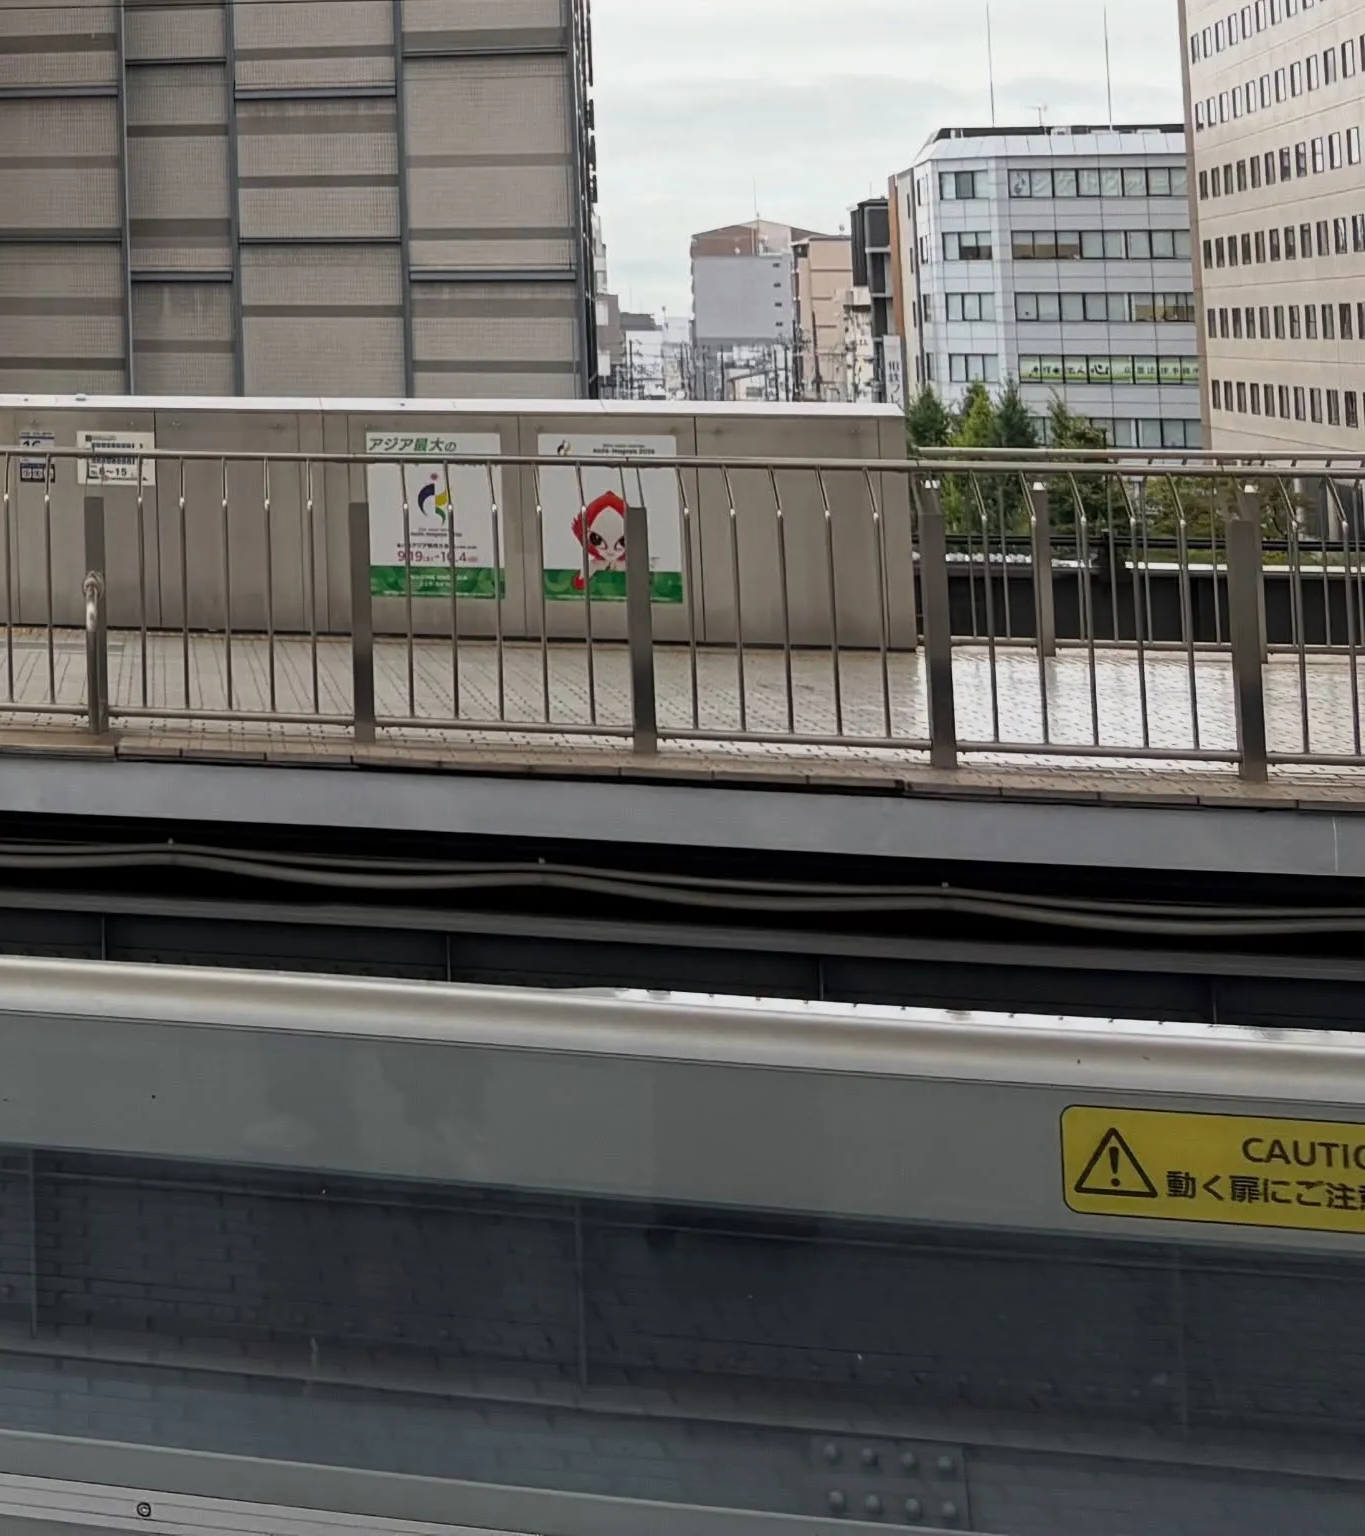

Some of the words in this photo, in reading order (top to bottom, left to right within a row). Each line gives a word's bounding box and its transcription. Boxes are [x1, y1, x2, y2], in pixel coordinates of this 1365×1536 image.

[1166, 1170, 1365, 1211] 動く扉にご注
